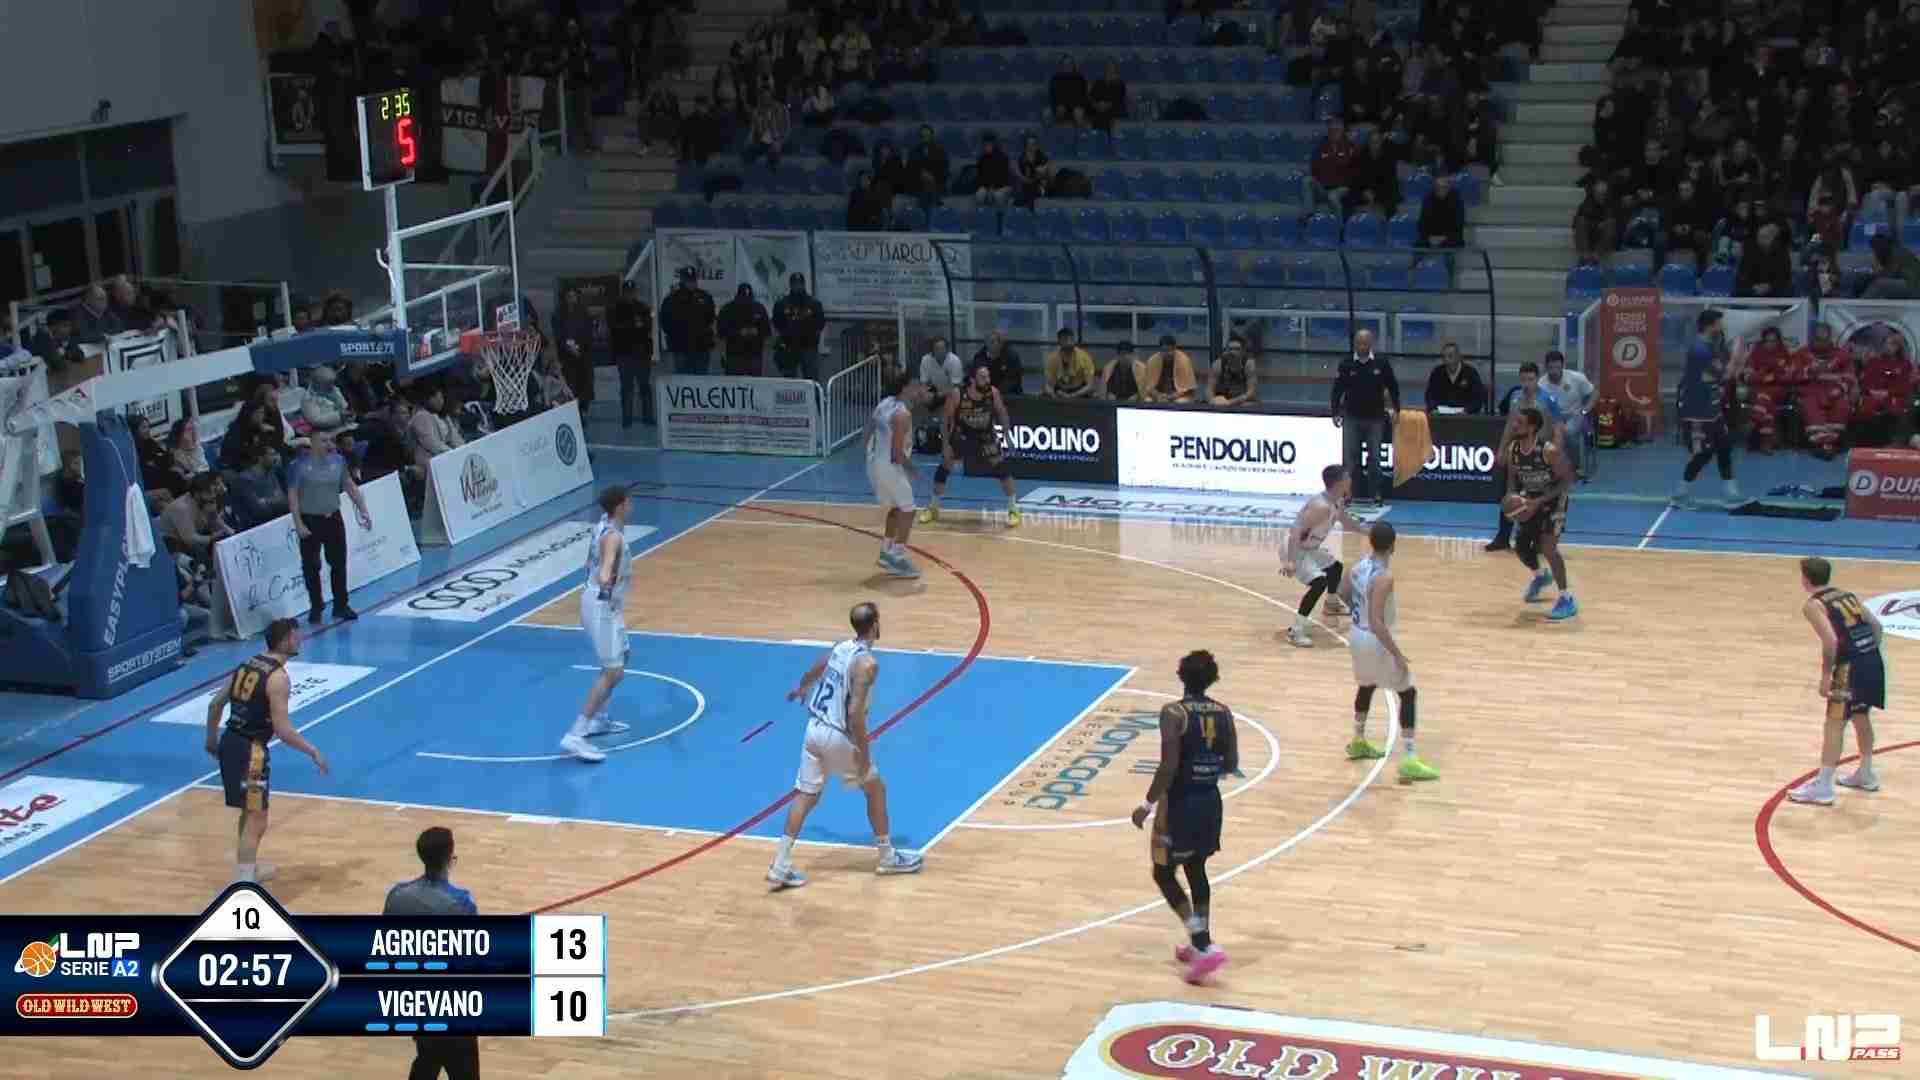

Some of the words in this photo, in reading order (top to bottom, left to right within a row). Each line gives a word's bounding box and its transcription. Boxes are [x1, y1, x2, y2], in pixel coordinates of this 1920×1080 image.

[396, 117, 417, 168] 5
[666, 384, 756, 411] VALENTI
[993, 424, 1101, 453] ENDOLINO
[1169, 435, 1297, 464] PENDOLINO
[231, 667, 261, 701] 19
[812, 681, 835, 713] 12
